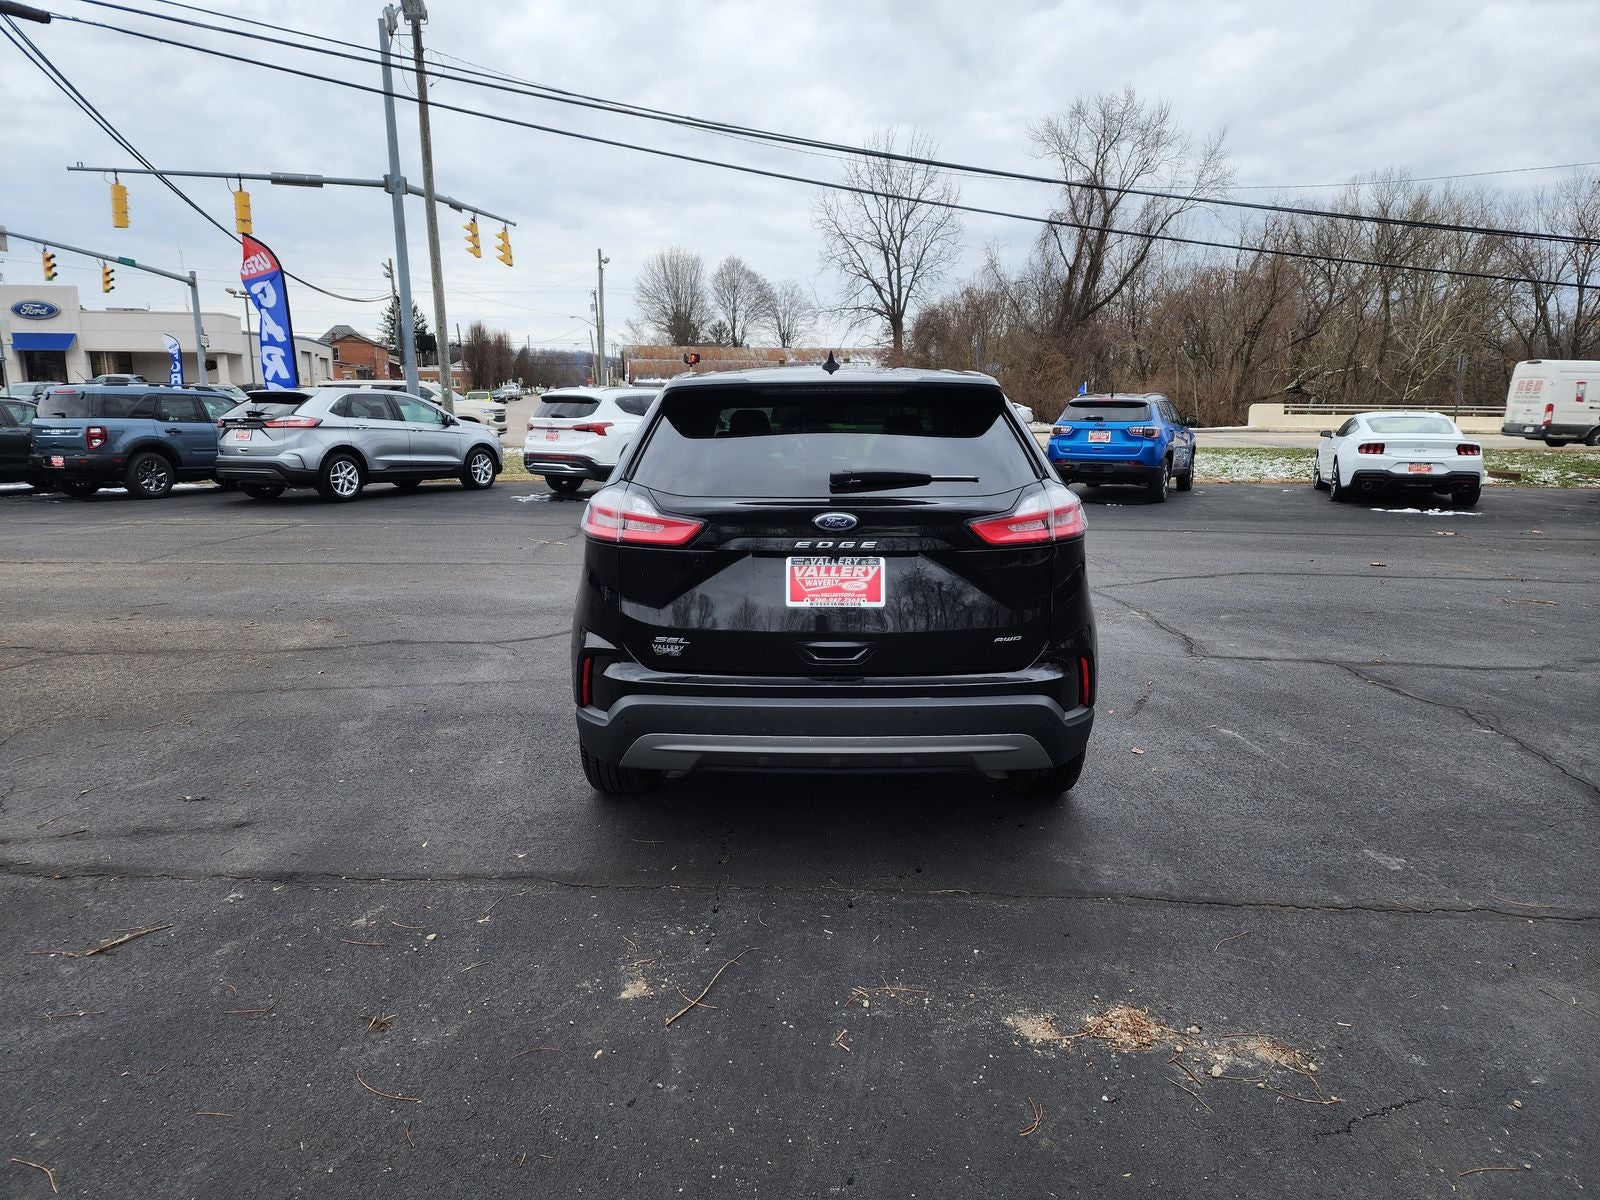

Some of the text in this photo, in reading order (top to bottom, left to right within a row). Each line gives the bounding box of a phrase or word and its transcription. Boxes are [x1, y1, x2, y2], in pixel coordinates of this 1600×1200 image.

[794, 541, 878, 549] EDGE
[810, 557, 859, 566] VALLERY
[793, 566, 880, 578] VALLERY
[653, 636, 691, 644] SEL
[993, 635, 1022, 643] AWD
